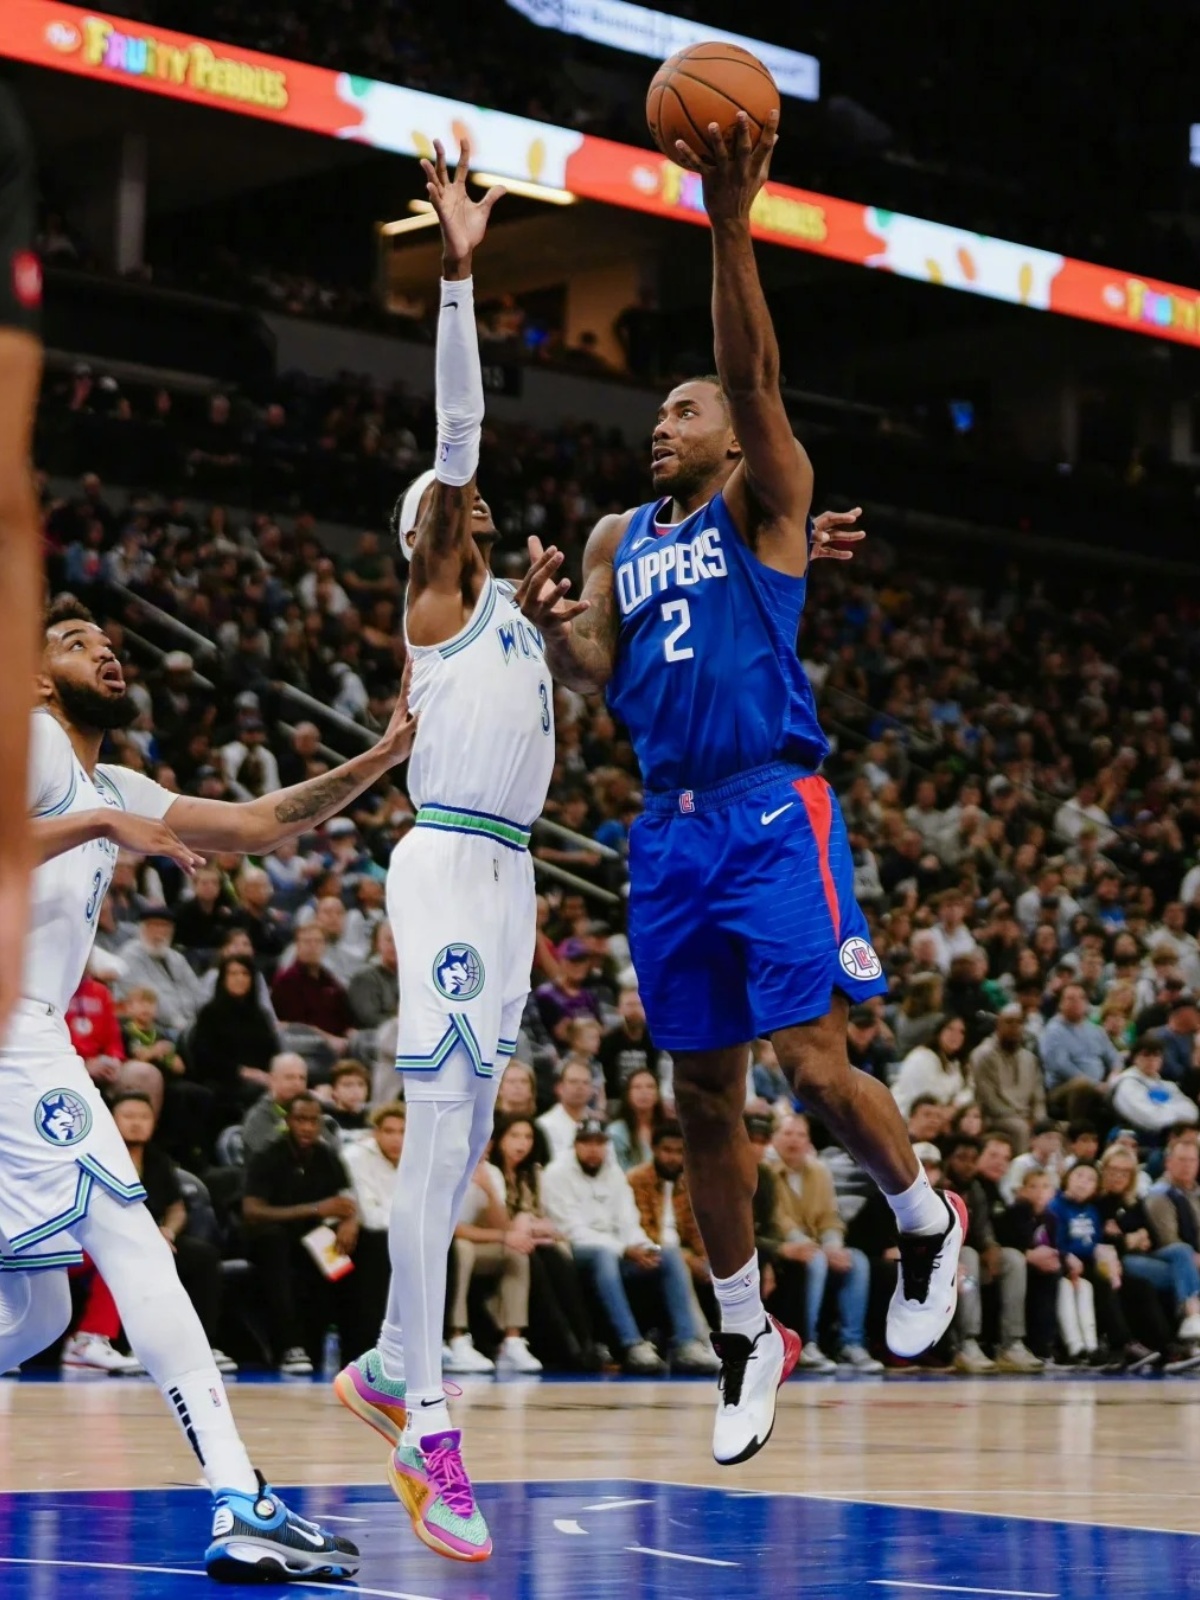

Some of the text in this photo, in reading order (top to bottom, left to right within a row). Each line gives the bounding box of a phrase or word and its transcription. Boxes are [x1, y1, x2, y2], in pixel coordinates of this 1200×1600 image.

[617, 527, 728, 615] CLIPPERS
[661, 598, 694, 663] 2
[538, 679, 550, 736] 3
